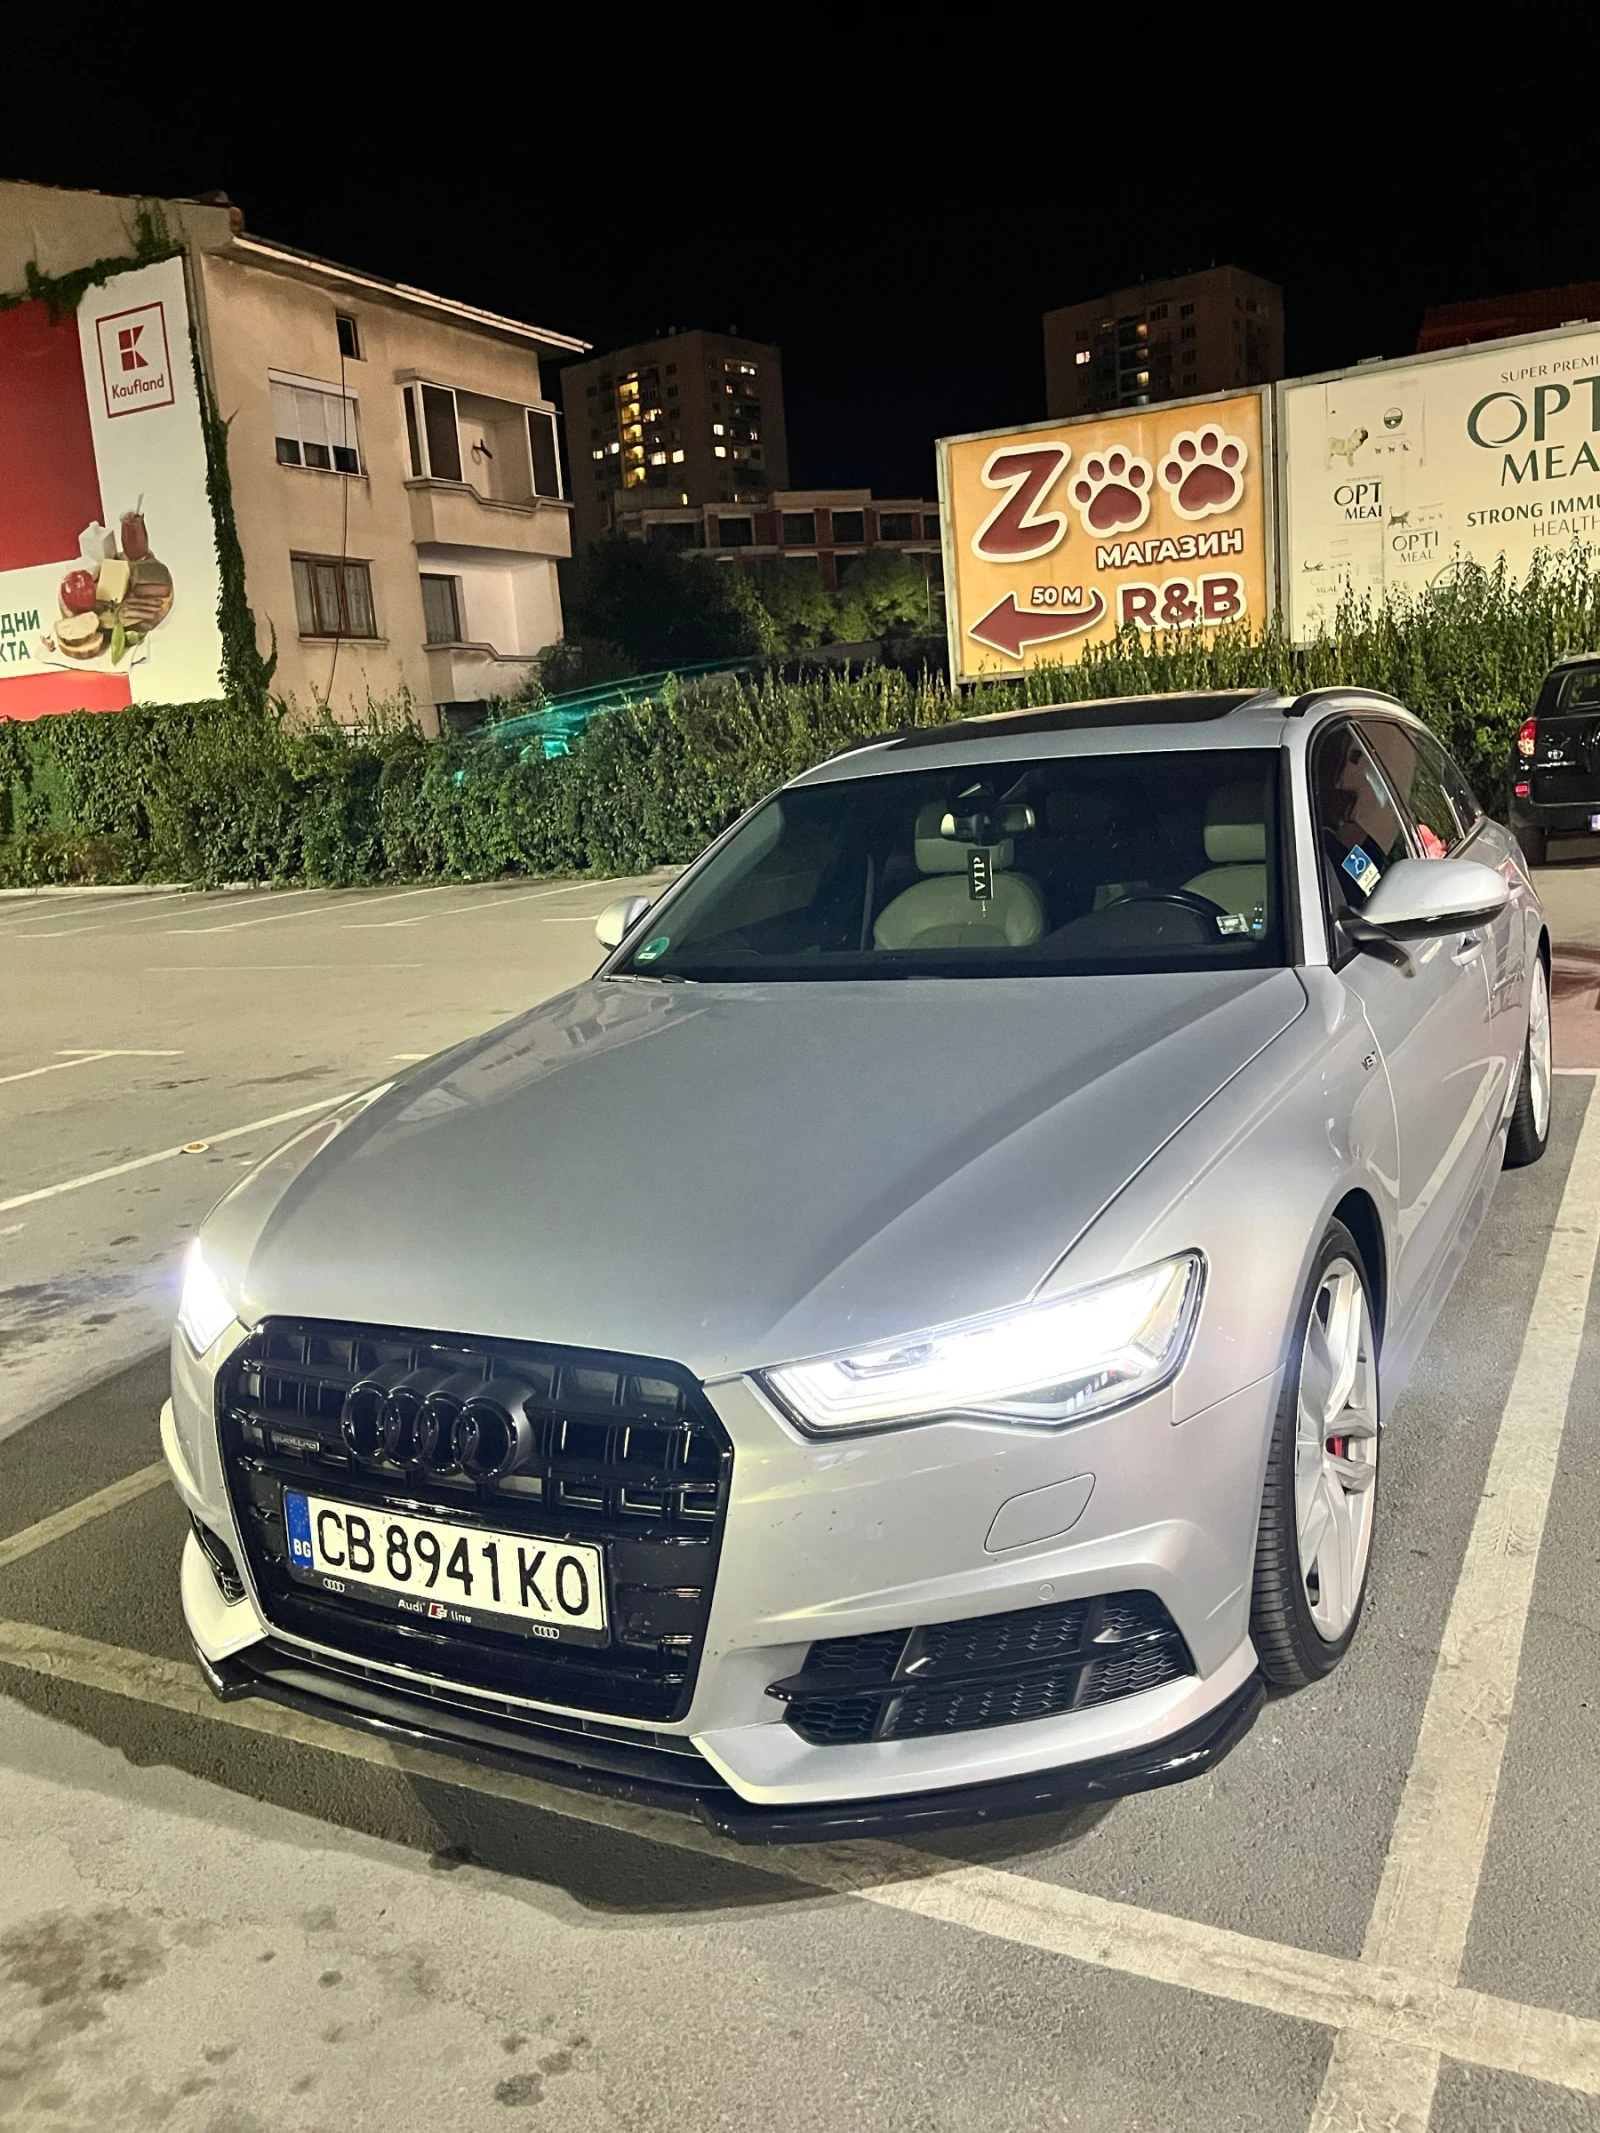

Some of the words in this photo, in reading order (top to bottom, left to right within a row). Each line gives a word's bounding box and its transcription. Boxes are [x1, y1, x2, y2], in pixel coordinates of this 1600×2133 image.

[111, 373, 165, 399] Kaufland
[1501, 364, 1547, 383] SUPER
[1501, 440, 1600, 487] MEA
[1466, 502, 1543, 527] STRONG
[1096, 528, 1243, 570] МАГАЗИН
[1392, 530, 1439, 552] OPTI
[1400, 549, 1435, 564] MEAL
[1031, 586, 1058, 606] 50
[1119, 574, 1243, 630] R&B
[973, 856, 986, 893] VIP
[293, 1538, 312, 1559] BG
[316, 1509, 375, 1573] CB
[386, 1524, 501, 1603] 8941
[450, 1609, 472, 1624] line
